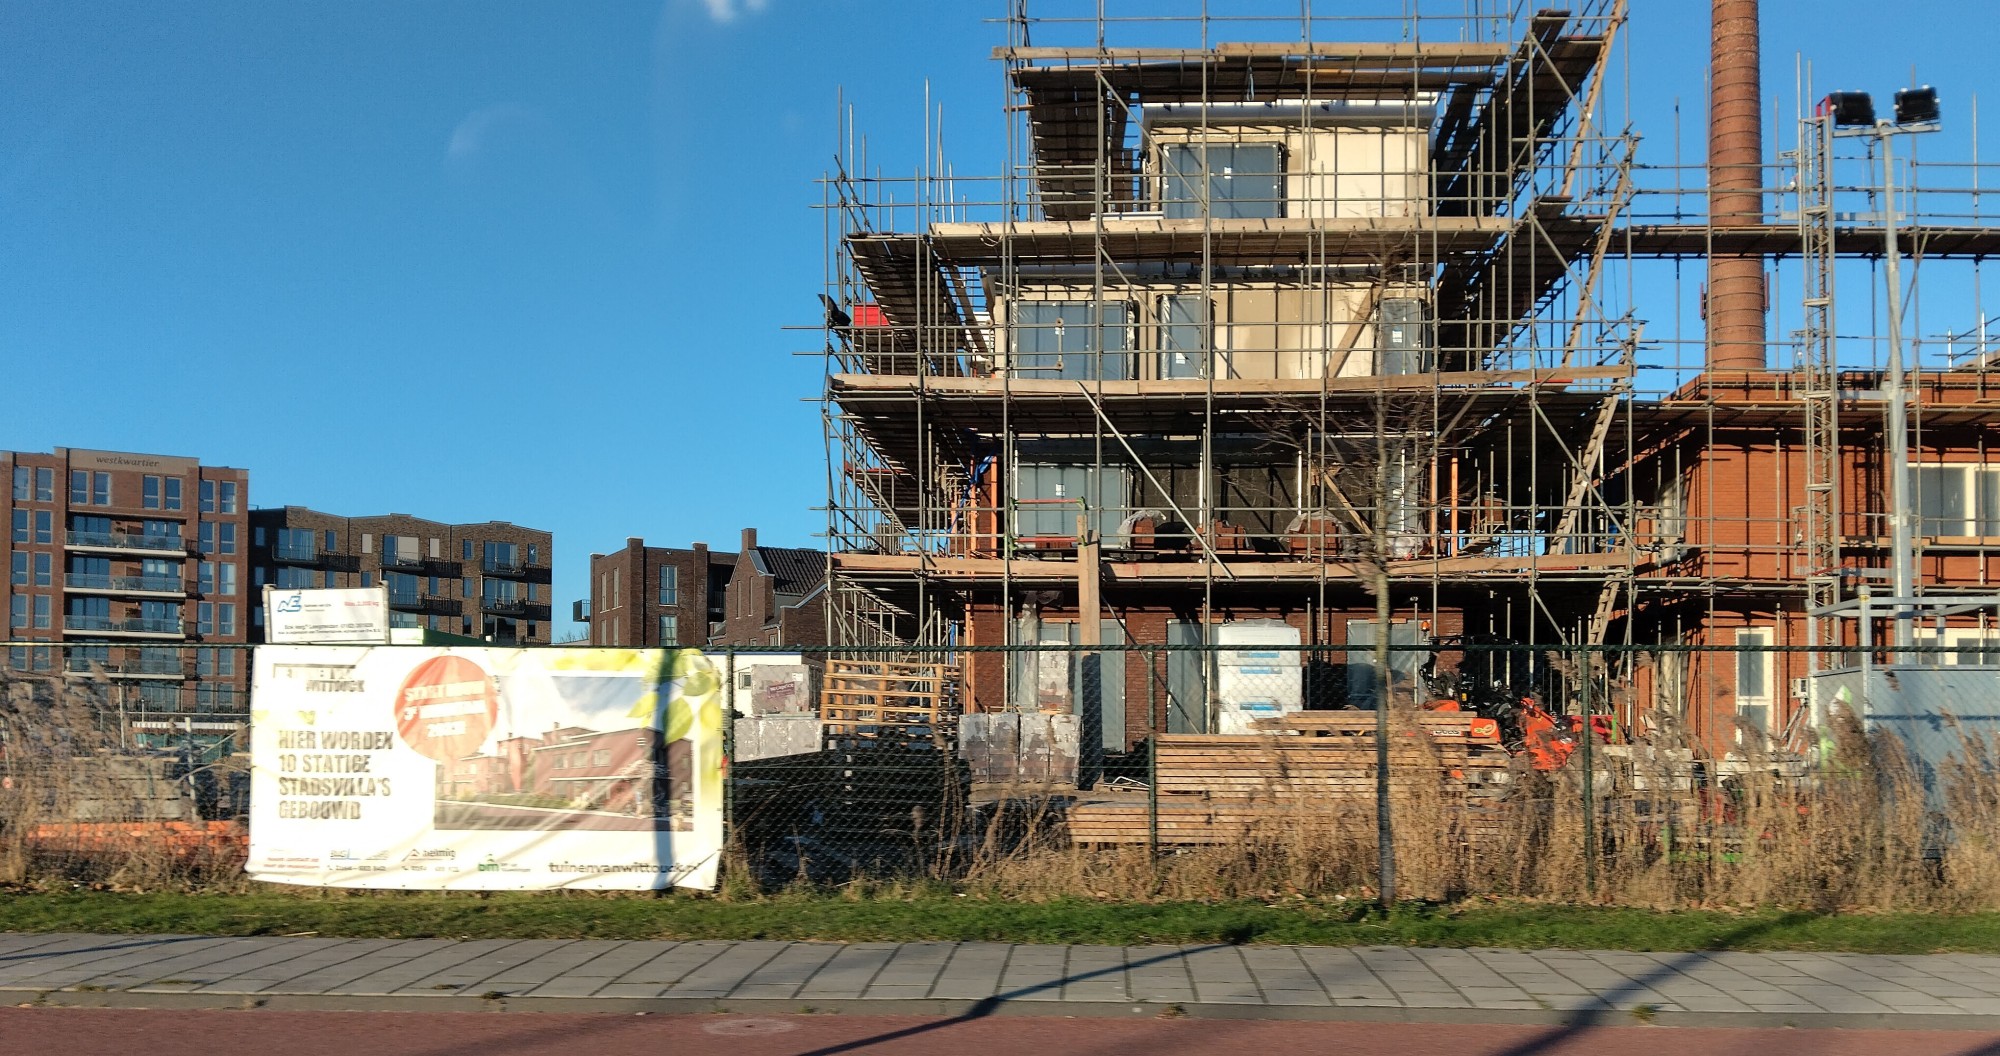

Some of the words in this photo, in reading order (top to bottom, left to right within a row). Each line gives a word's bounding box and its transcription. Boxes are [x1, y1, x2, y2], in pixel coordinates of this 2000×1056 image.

[96, 456, 160, 467] westkwartier
[279, 730, 316, 749] HIER
[321, 731, 393, 749] WORDEN
[279, 754, 296, 772] 10
[303, 755, 371, 773] STATIGE
[279, 777, 391, 796] STADSVILLA'S
[279, 801, 361, 820] GEBOUWD
